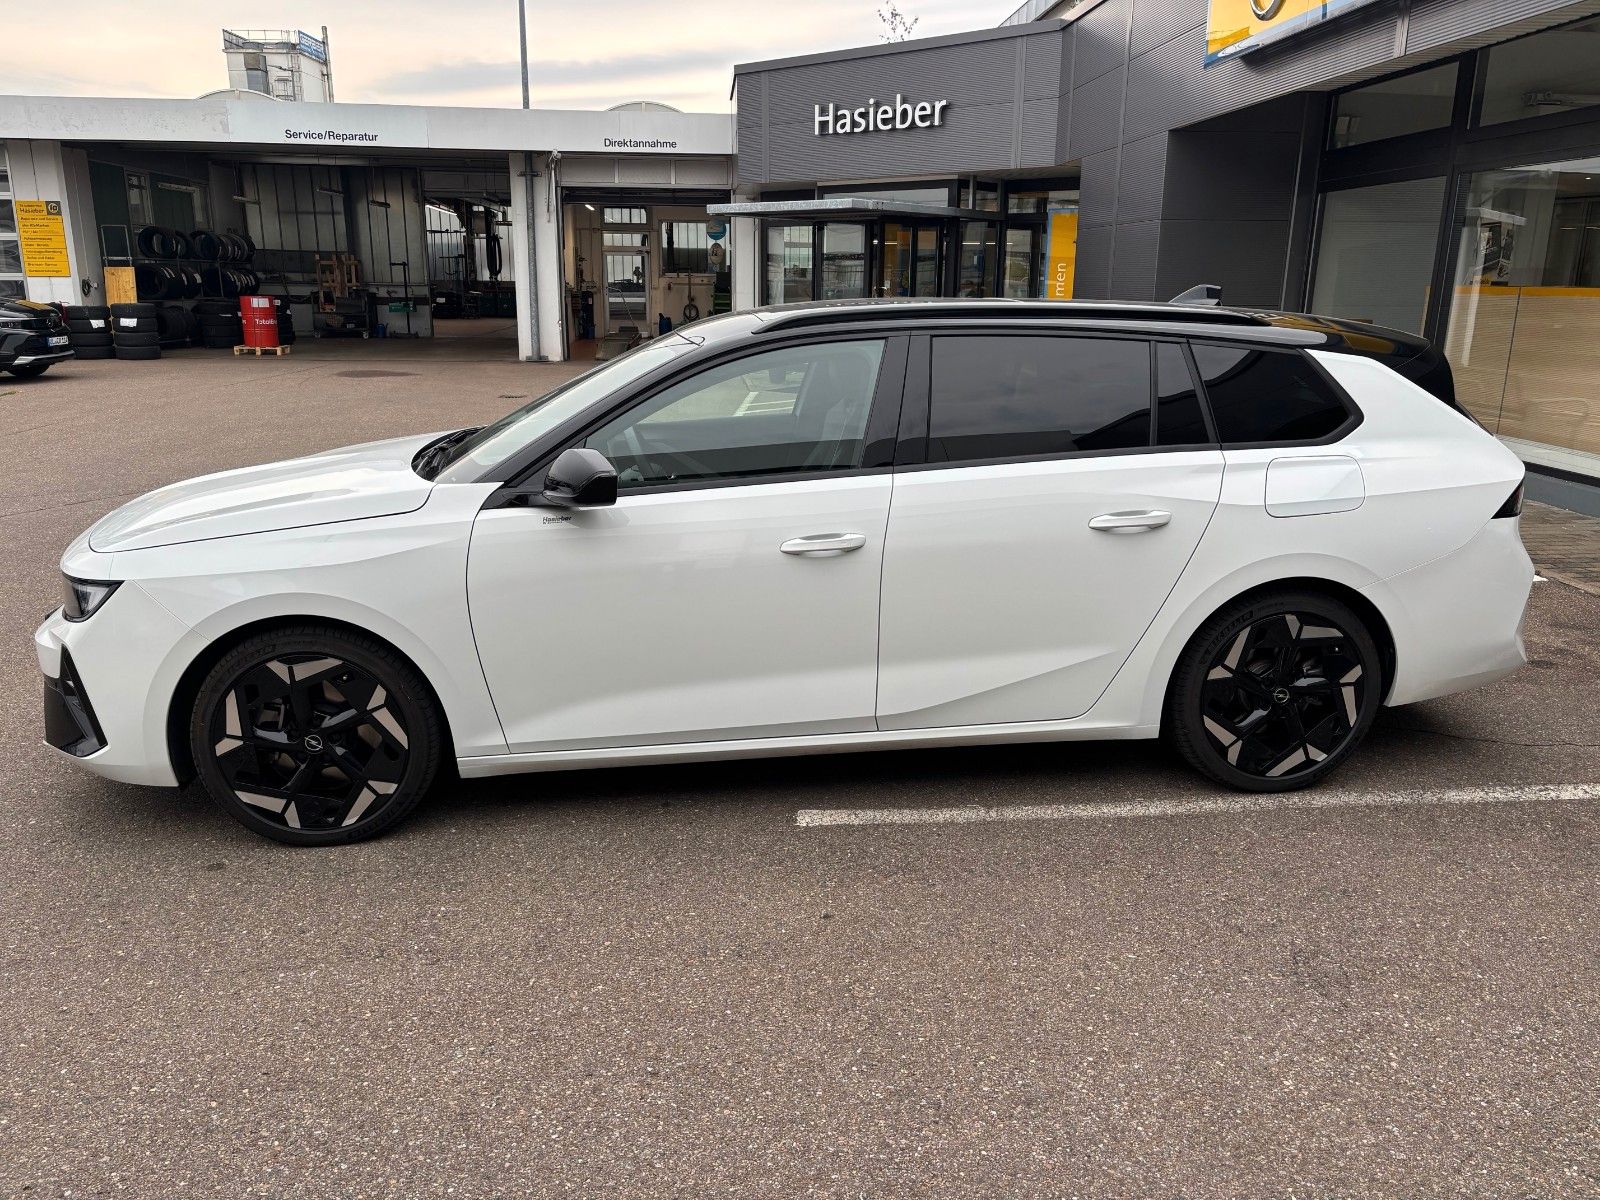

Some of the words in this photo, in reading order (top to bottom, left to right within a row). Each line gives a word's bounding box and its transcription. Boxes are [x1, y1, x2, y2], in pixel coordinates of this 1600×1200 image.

[814, 93, 947, 135] Hasieber
[285, 129, 379, 142] Service/Reparatur
[604, 138, 677, 148] Direktannahme
